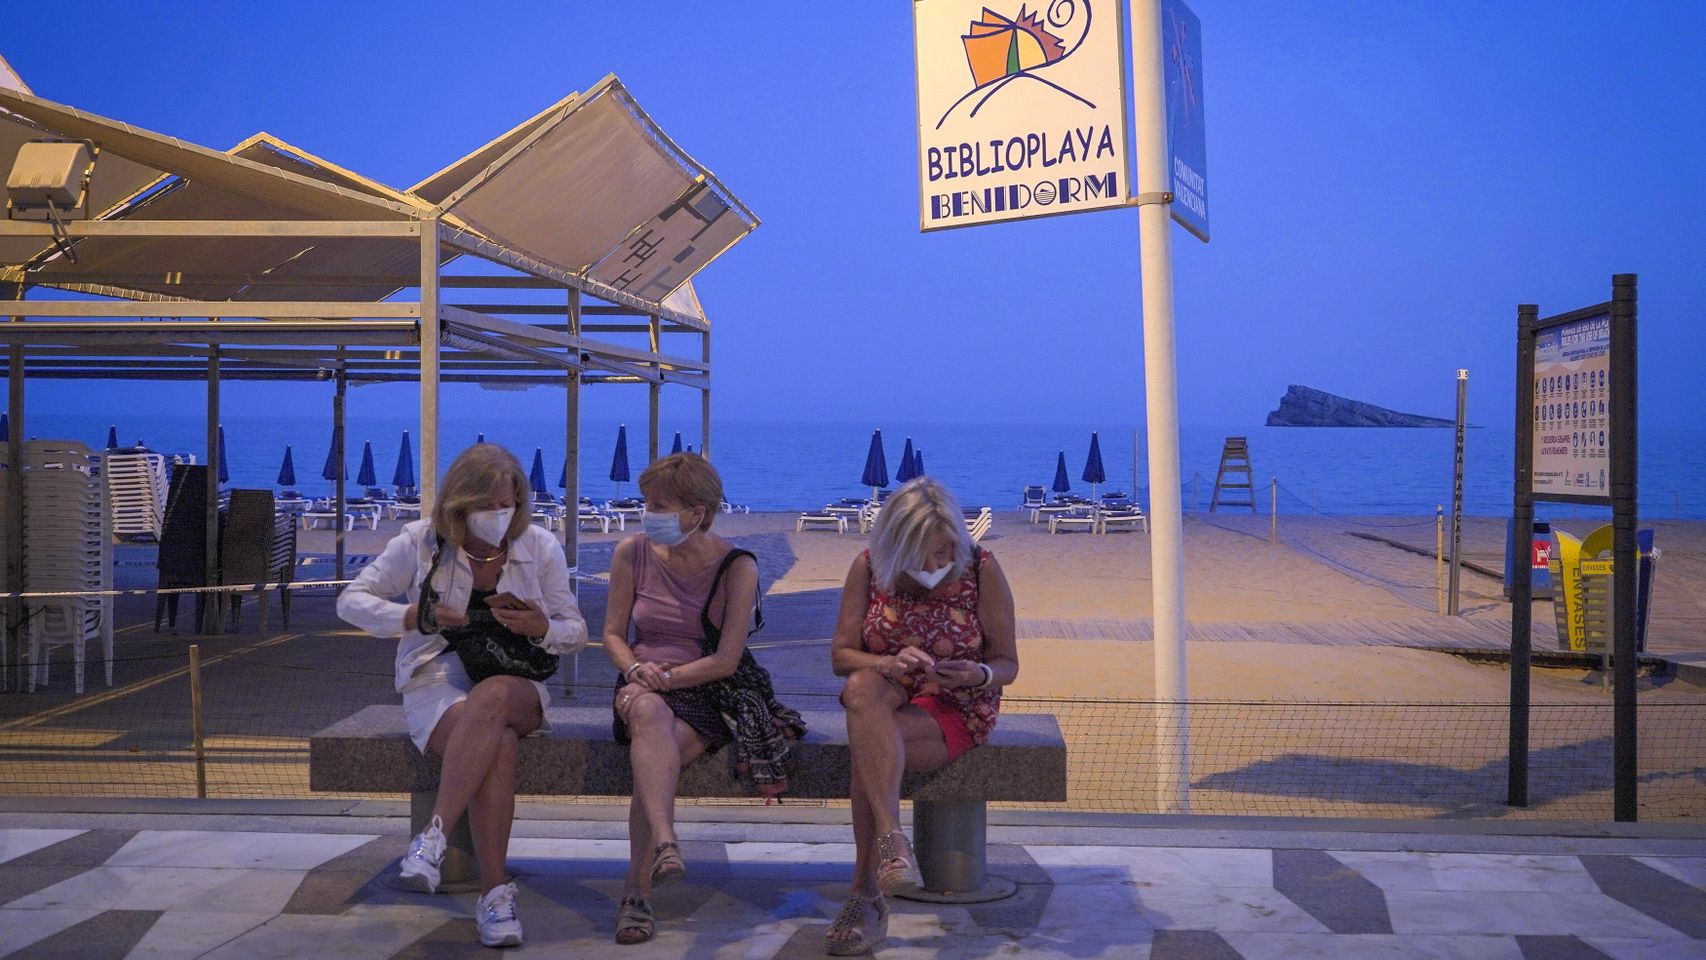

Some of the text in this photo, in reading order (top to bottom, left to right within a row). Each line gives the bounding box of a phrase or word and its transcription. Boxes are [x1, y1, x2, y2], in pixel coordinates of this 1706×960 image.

[928, 124, 1115, 182] BIBLIOPLAYA
[931, 172, 1118, 220] BENIDORM
[1572, 566, 1585, 649] ENVASES
